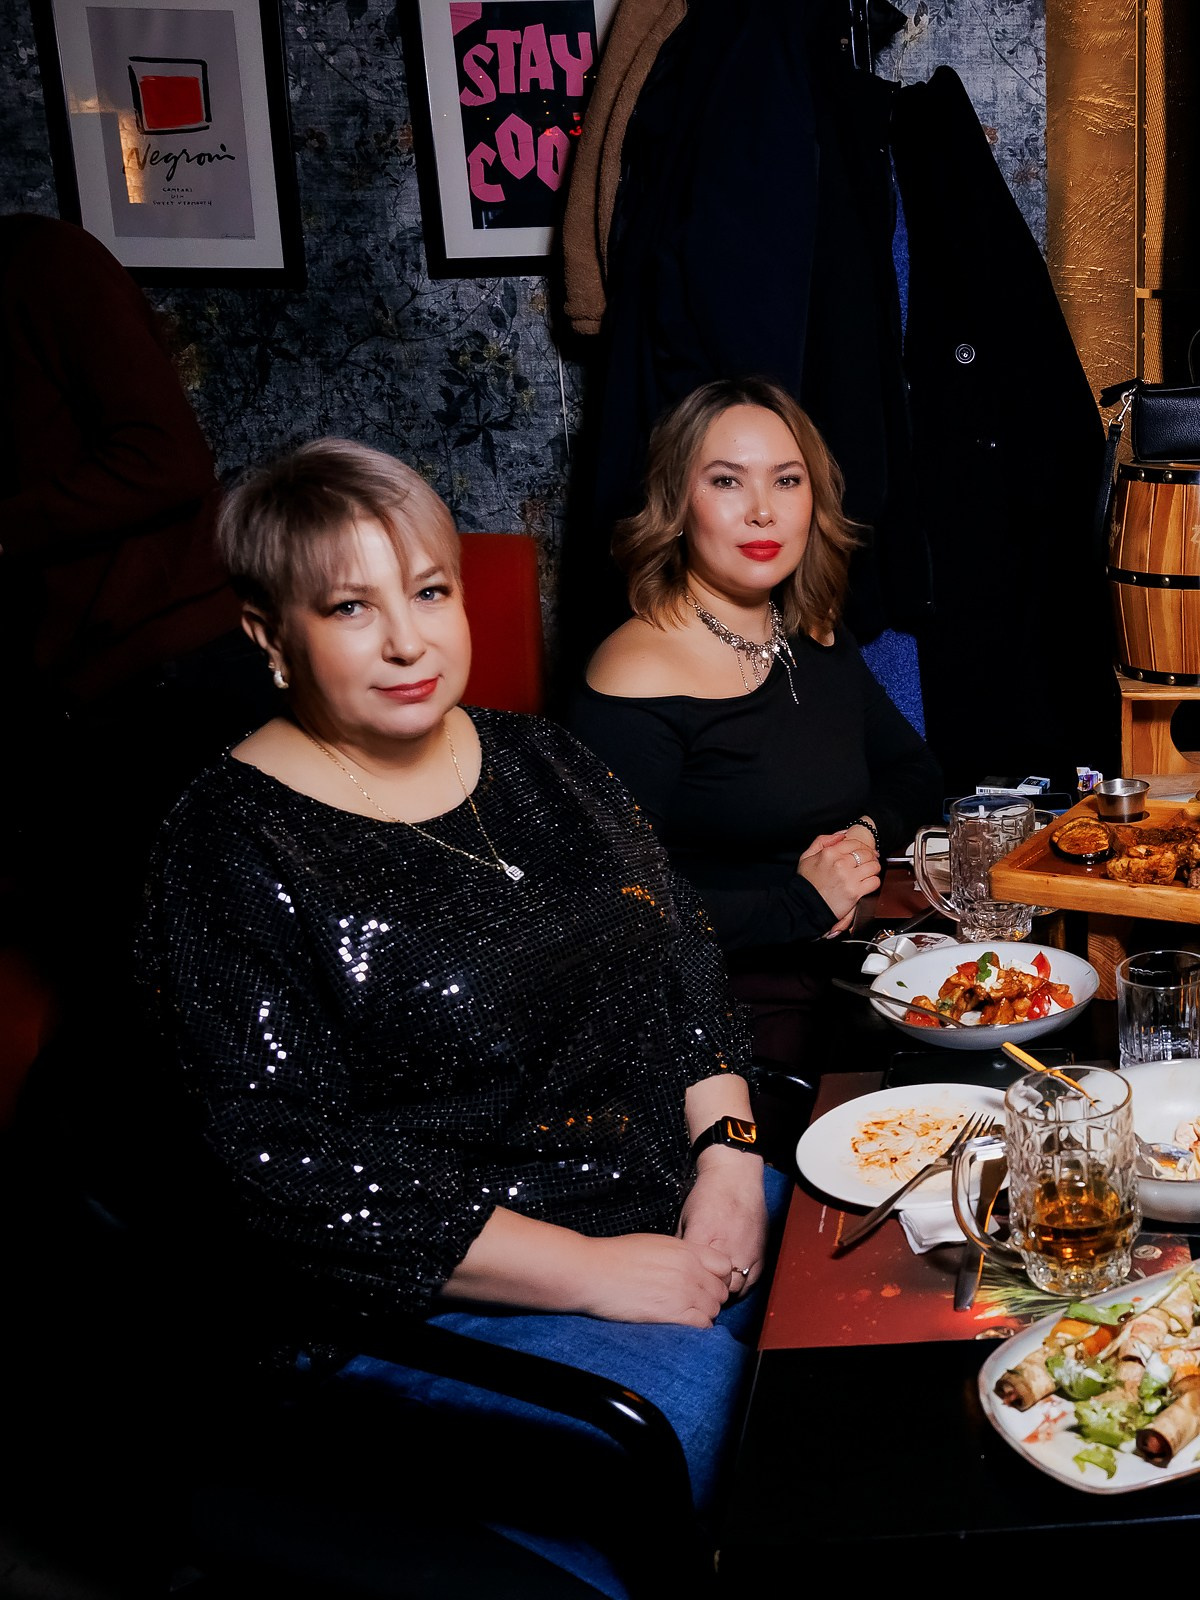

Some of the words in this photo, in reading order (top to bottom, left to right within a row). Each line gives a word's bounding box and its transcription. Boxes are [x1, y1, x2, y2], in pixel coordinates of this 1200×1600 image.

[460, 23, 593, 107] STAY
[122, 143, 236, 182] Negroni
[467, 113, 572, 203] COO
